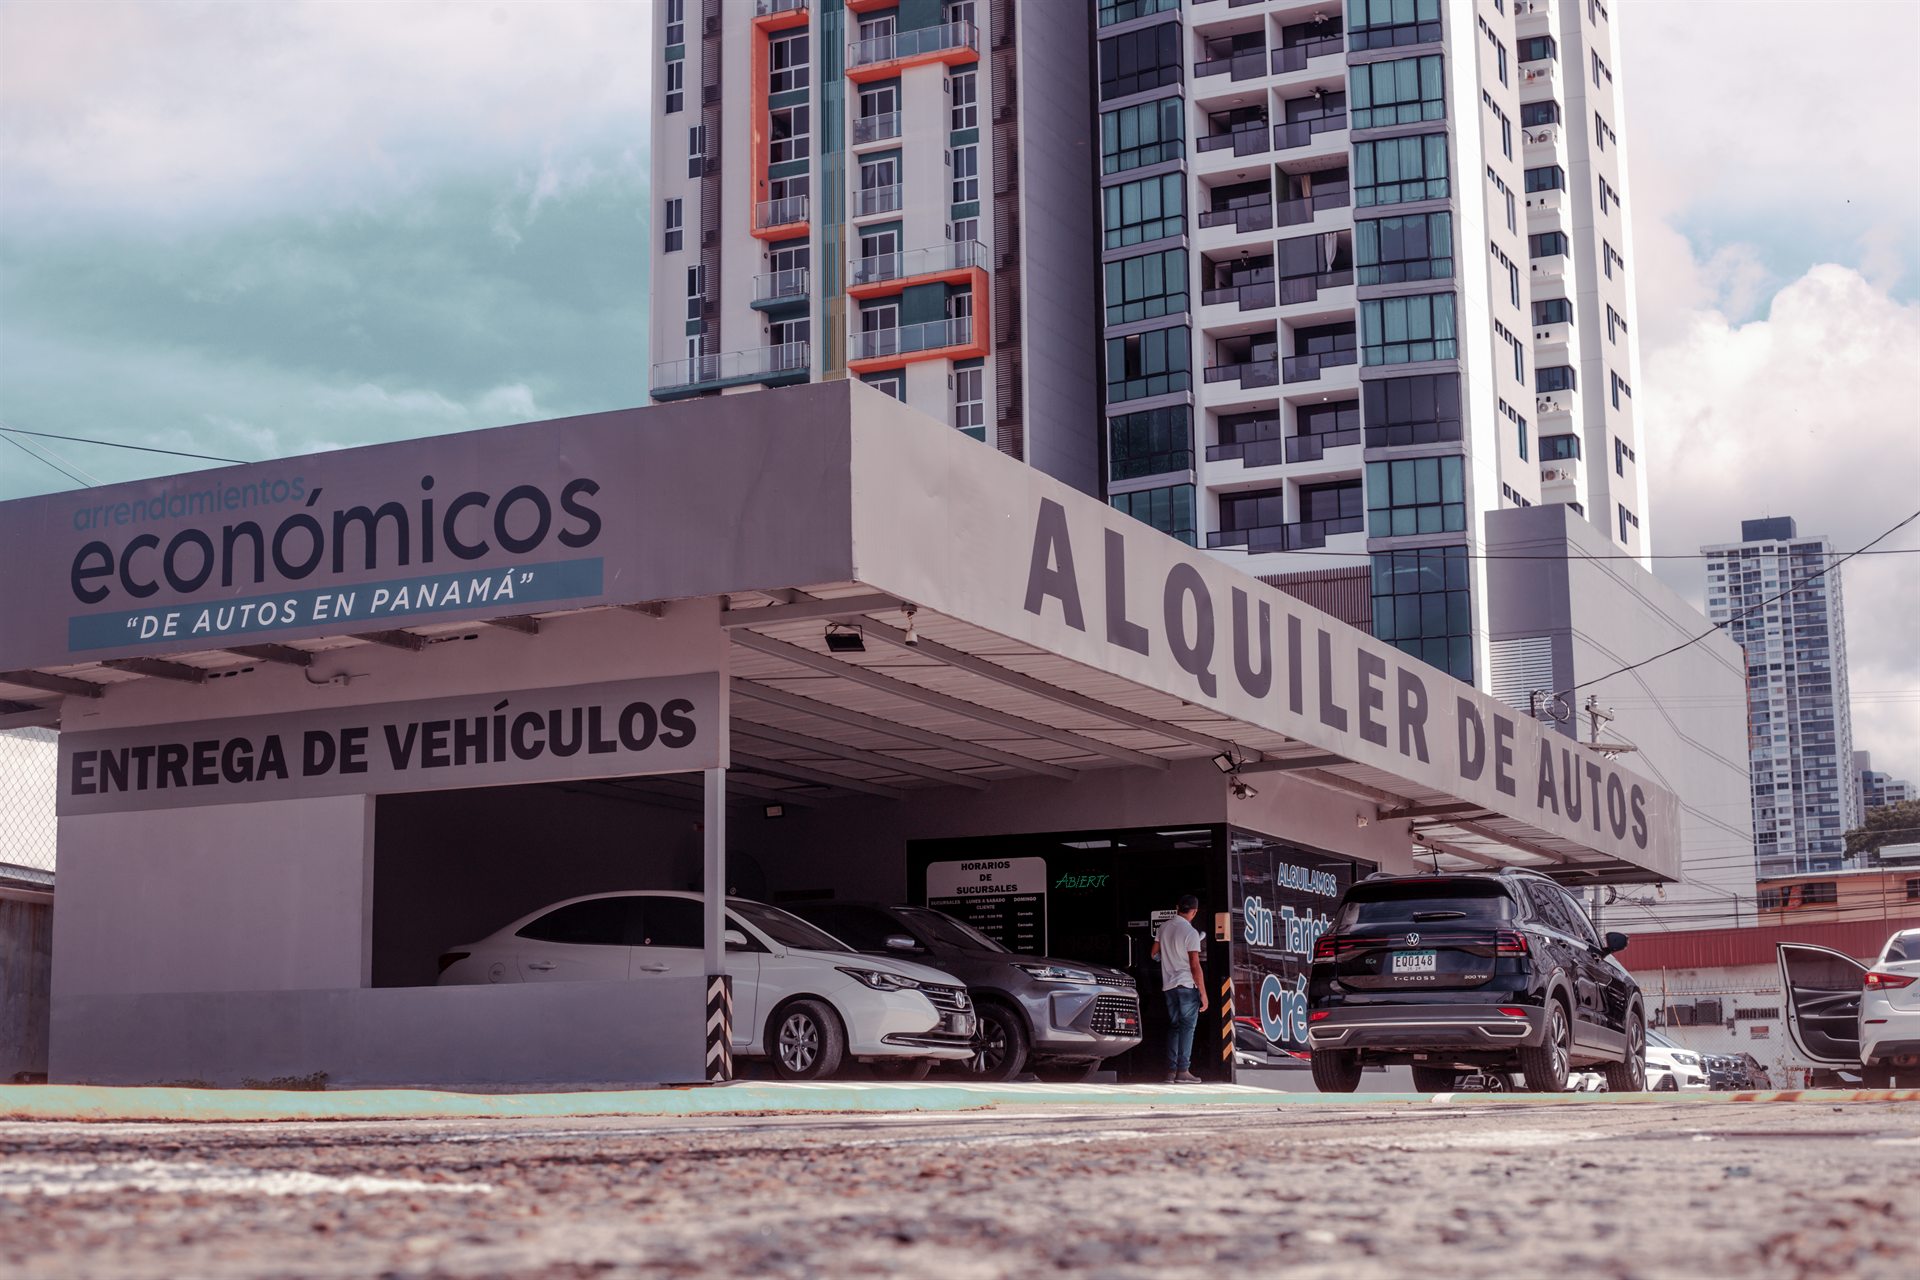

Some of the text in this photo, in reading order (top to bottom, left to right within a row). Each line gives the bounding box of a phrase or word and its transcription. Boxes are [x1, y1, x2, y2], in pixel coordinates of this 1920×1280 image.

[73, 476, 305, 532] arrendamientos
[71, 475, 602, 604] económicos
[192, 600, 298, 634] AUTOS
[312, 594, 356, 621] EN
[1024, 497, 1649, 850] ALQUILER DE AUTOS
[72, 699, 697, 795] ENTREGA DE VEHÍCULOS
[956, 885, 1018, 895] SUCURSALES
[961, 861, 1010, 871] HORARIOS
[1277, 862, 1337, 897] ALQUILAMOS
[1244, 896, 1336, 963] Sin Tarjet
